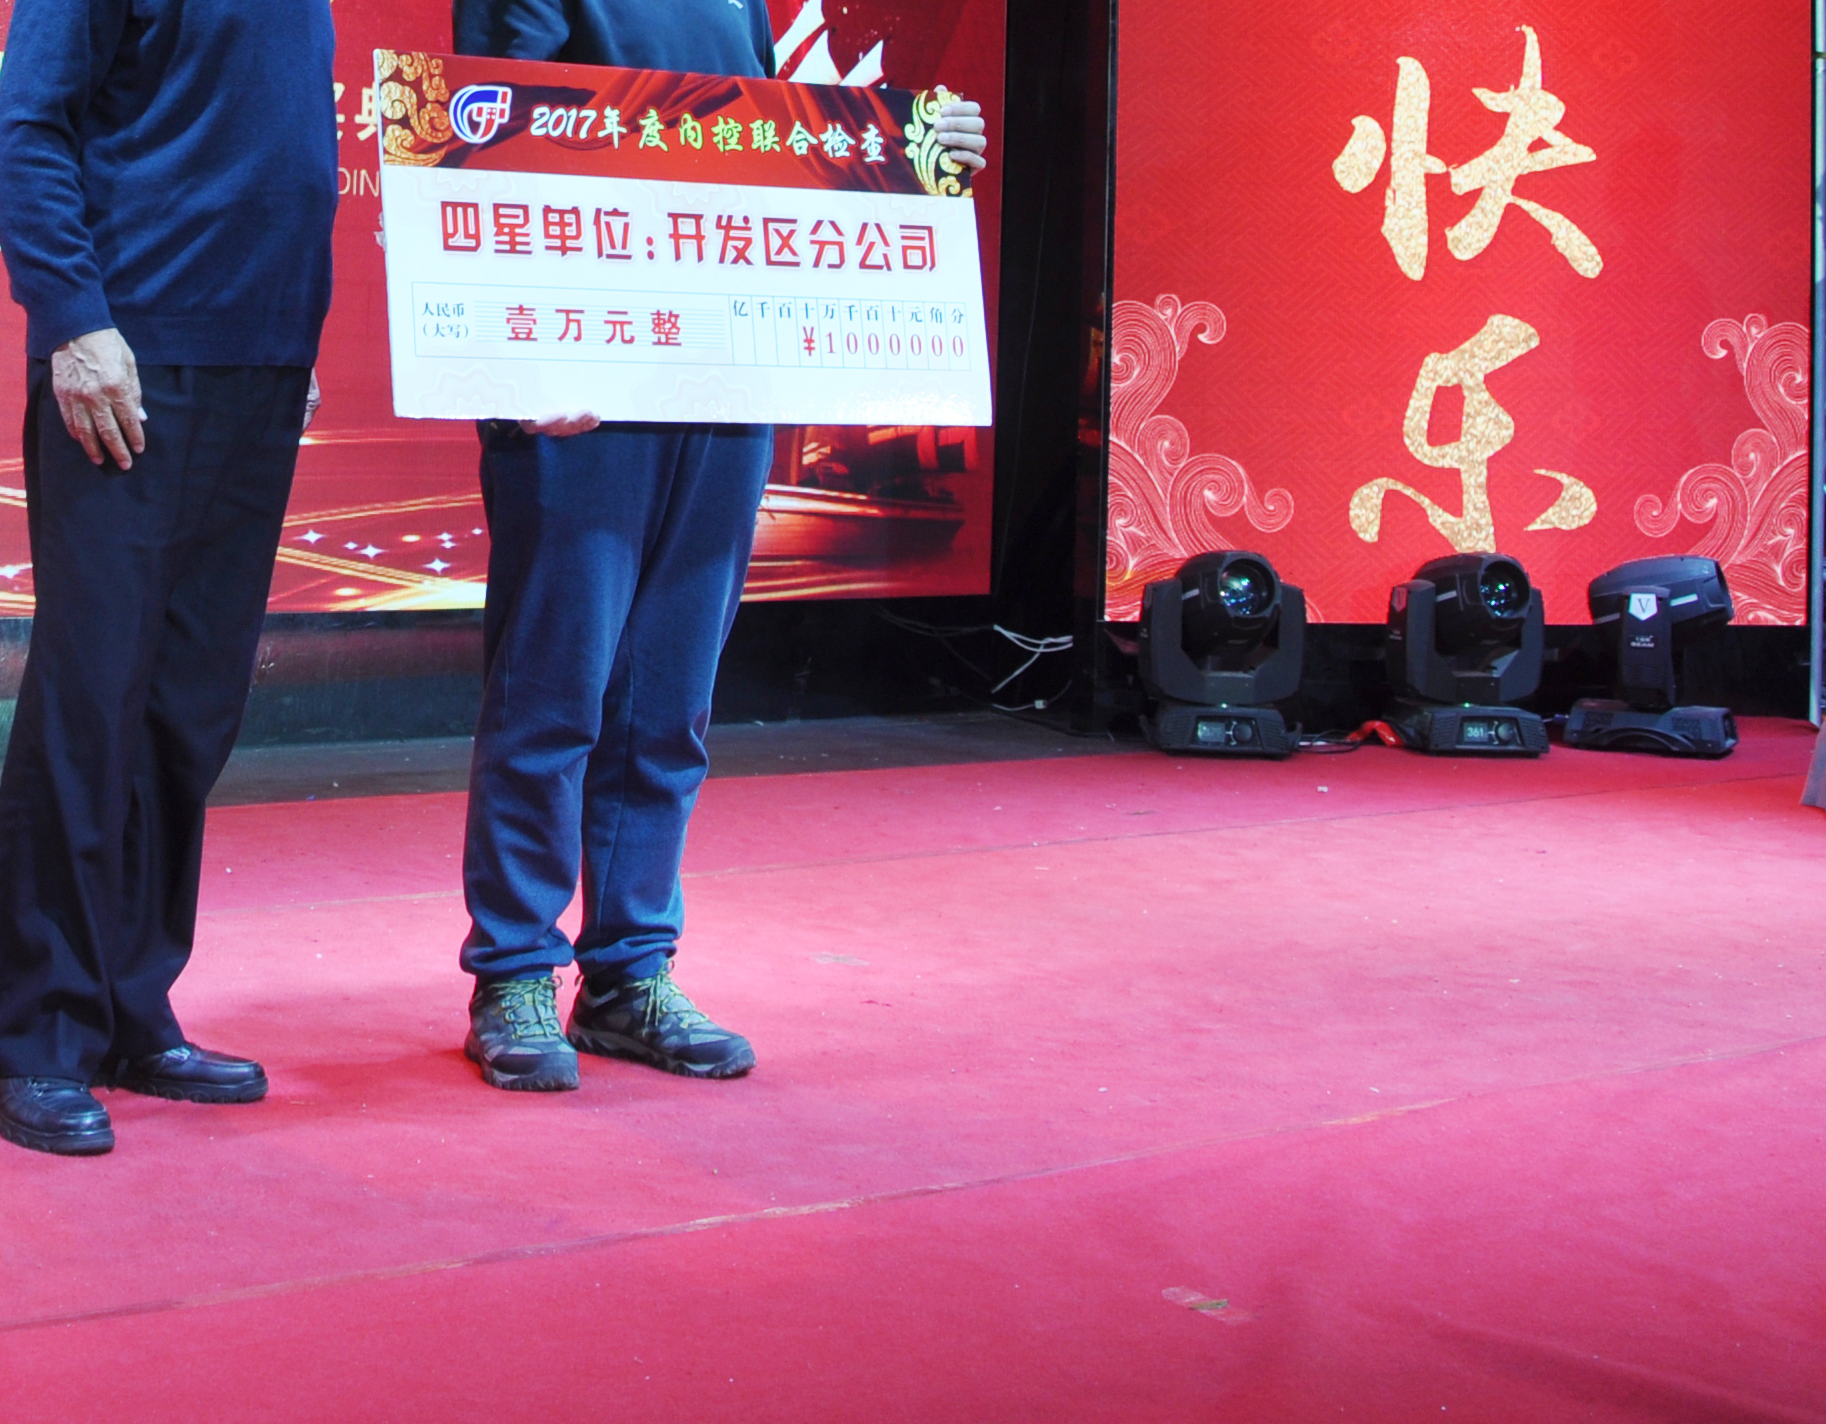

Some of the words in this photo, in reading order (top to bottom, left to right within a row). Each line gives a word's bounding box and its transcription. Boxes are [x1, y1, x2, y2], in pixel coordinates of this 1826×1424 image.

[529, 102, 888, 163] 2017年度内控联合检查
[439, 198, 938, 273] 四星单位:开发区分公司
[421, 302, 466, 319] 人民币
[505, 304, 683, 347] 壹万元整
[1466, 725, 1485, 737] 361
